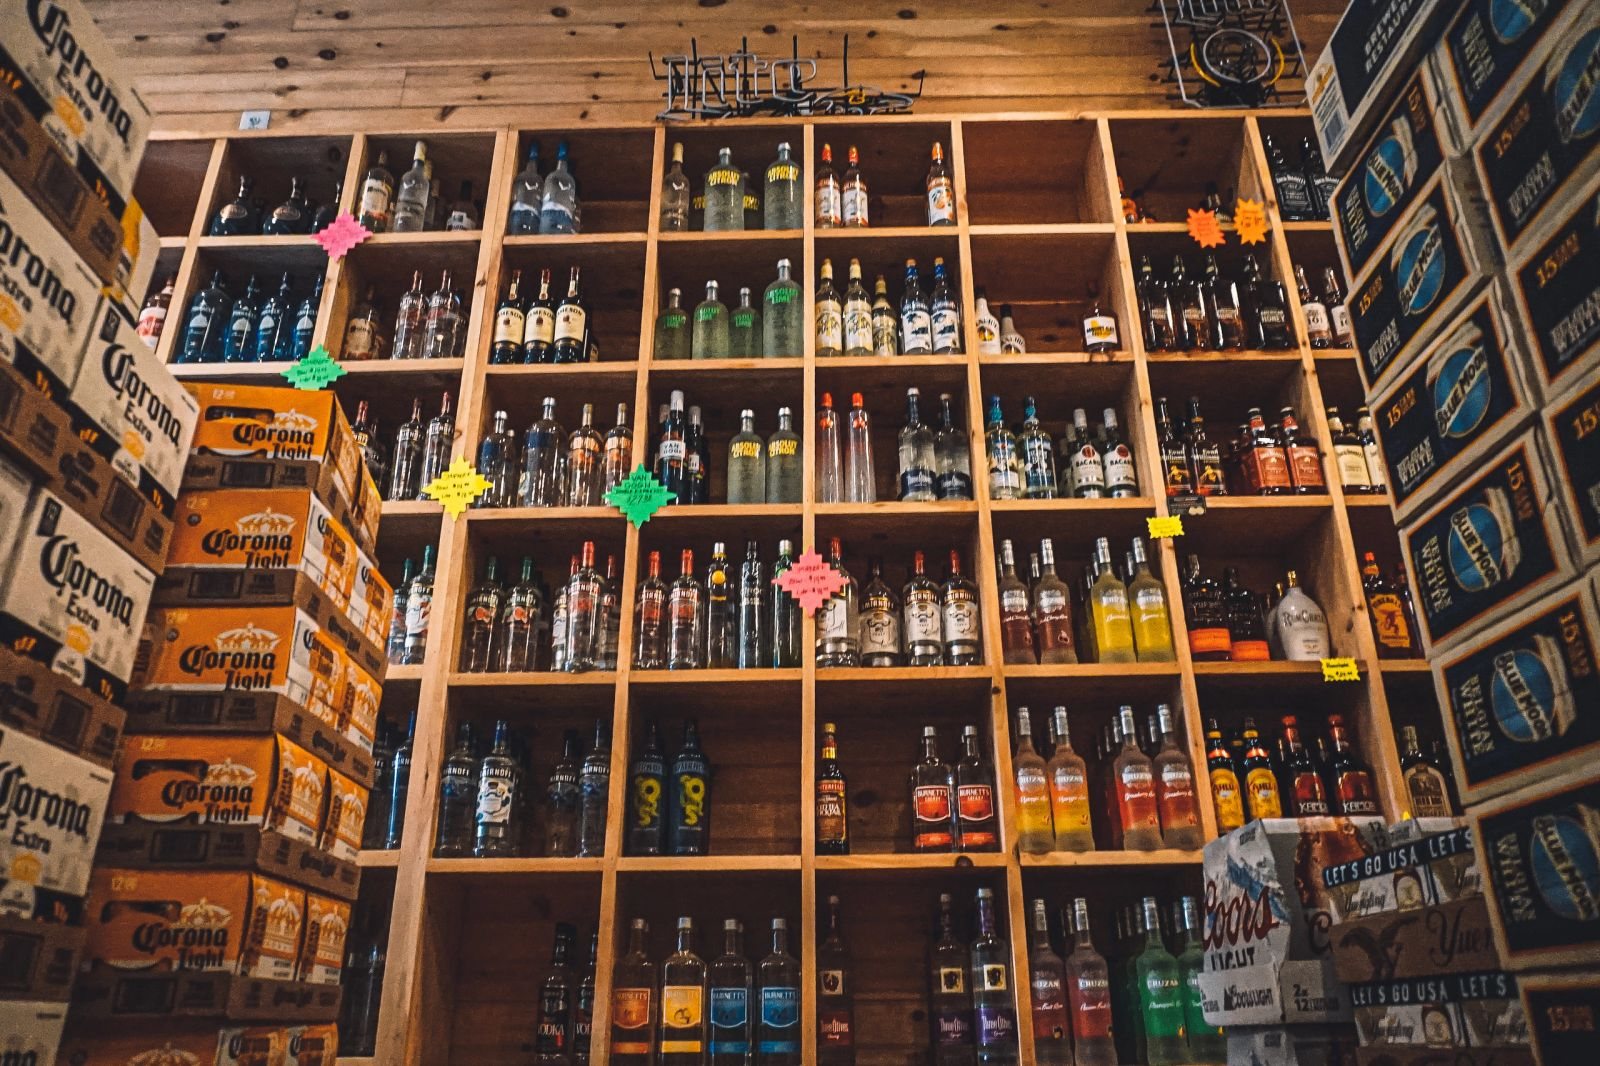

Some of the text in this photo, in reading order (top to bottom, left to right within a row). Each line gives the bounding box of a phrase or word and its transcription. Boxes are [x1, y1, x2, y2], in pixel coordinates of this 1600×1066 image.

[0, 219, 76, 325] orona
[1262, 314, 1285, 323] HONEY
[102, 344, 182, 446] Corona
[1437, 350, 1486, 436] BLUE MOON
[124, 401, 153, 442] Extra
[1387, 404, 1401, 428] 15
[232, 423, 314, 448] Corona
[271, 442, 313, 462] Light
[201, 529, 293, 557] Corona
[1452, 510, 1499, 585] BLUE MOON
[244, 551, 289, 570] Light
[41, 535, 134, 632] Corona
[906, 593, 938, 602] SMIRNOFF
[66, 597, 98, 630] Extra
[179, 644, 276, 675] Corona
[224, 670, 272, 691] Light
[1495, 652, 1550, 737] BLUE MOON
[480, 766, 512, 778] SMIRNOFF
[162, 779, 253, 808] Corona
[203, 801, 250, 823] Light
[11, 820, 51, 853] Extra
[1535, 817, 1567, 863] BLUE
[1326, 831, 1474, 886] LET'S GO USA LET'S
[1203, 881, 1280, 951] Coors
[132, 922, 228, 951] Corona
[178, 948, 225, 970] Light
[1352, 974, 1508, 1005] LET'S GO USA LET'S
[576, 1024, 592, 1034] VOD
